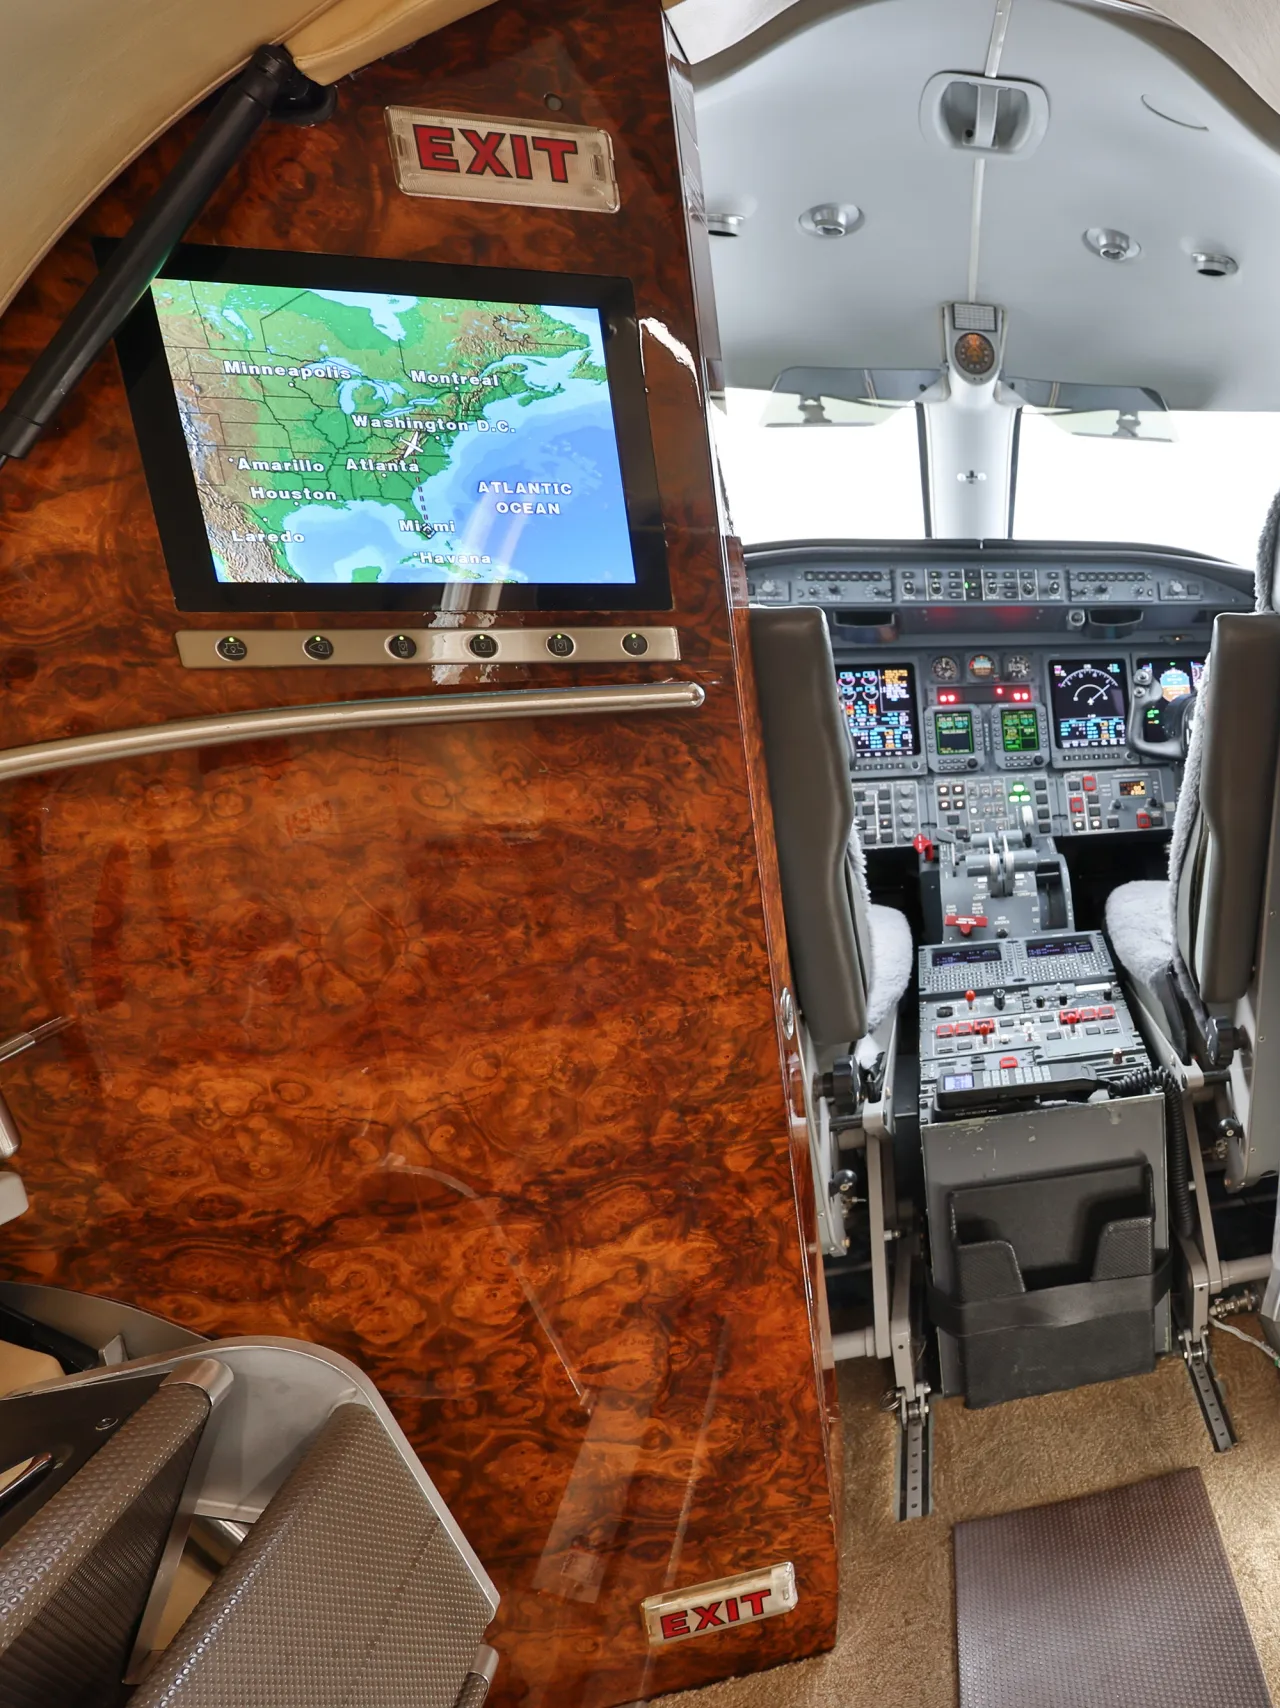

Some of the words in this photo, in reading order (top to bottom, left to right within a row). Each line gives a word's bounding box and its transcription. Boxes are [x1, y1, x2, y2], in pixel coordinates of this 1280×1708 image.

[412, 123, 578, 184] EXIT
[223, 360, 352, 380] Minneapolis
[411, 369, 499, 387] Montreal
[352, 414, 469, 432] Washington
[477, 419, 516, 433] D.C.
[237, 458, 325, 473] Amarillo
[346, 458, 420, 473] Atlanta
[250, 486, 337, 500] Houston
[478, 481, 573, 495] ATLANTIC
[496, 502, 561, 515] OCEAN
[399, 520, 456, 533] Mimi
[232, 530, 305, 543] Laredo
[420, 552, 492, 565] Havana
[660, 1588, 771, 1640] EXIT
